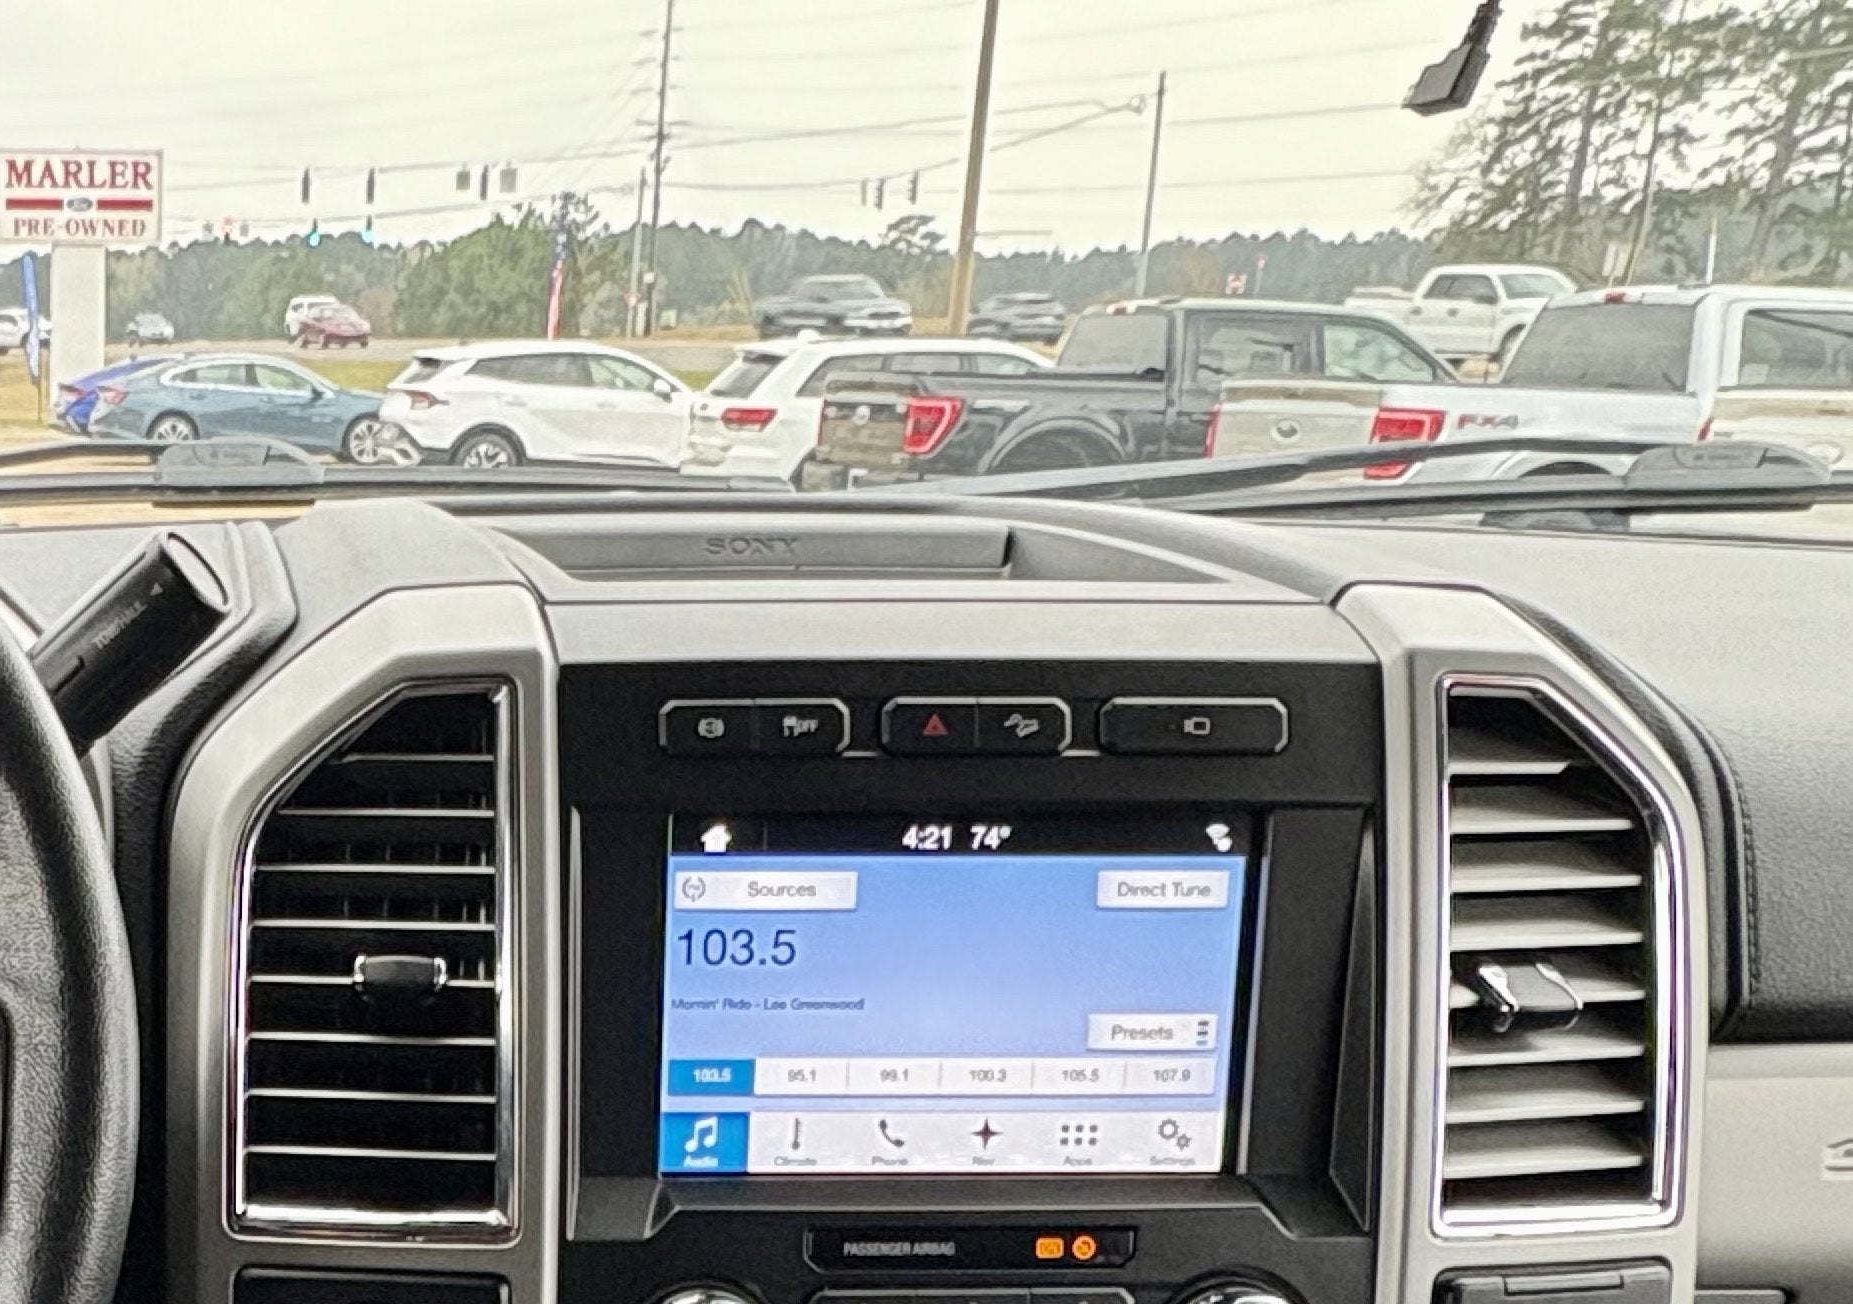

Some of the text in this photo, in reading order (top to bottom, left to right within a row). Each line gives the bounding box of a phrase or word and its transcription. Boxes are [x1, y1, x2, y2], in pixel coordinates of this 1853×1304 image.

[4, 159, 154, 190] MARLER
[13, 217, 146, 237] PRE-OWNED
[704, 537, 799, 556] SONY
[901, 824, 953, 851] 4:21
[746, 881, 817, 898] Sources
[1116, 881, 1212, 898] Direct Tune
[676, 927, 798, 968] 103.5
[763, 997, 787, 1011] Lee
[1111, 1024, 1174, 1042] Presets
[693, 1068, 732, 1083] 103.5
[969, 1068, 1007, 1083] 100.3
[843, 1241, 956, 1257] PASSENGER AIRBAG
